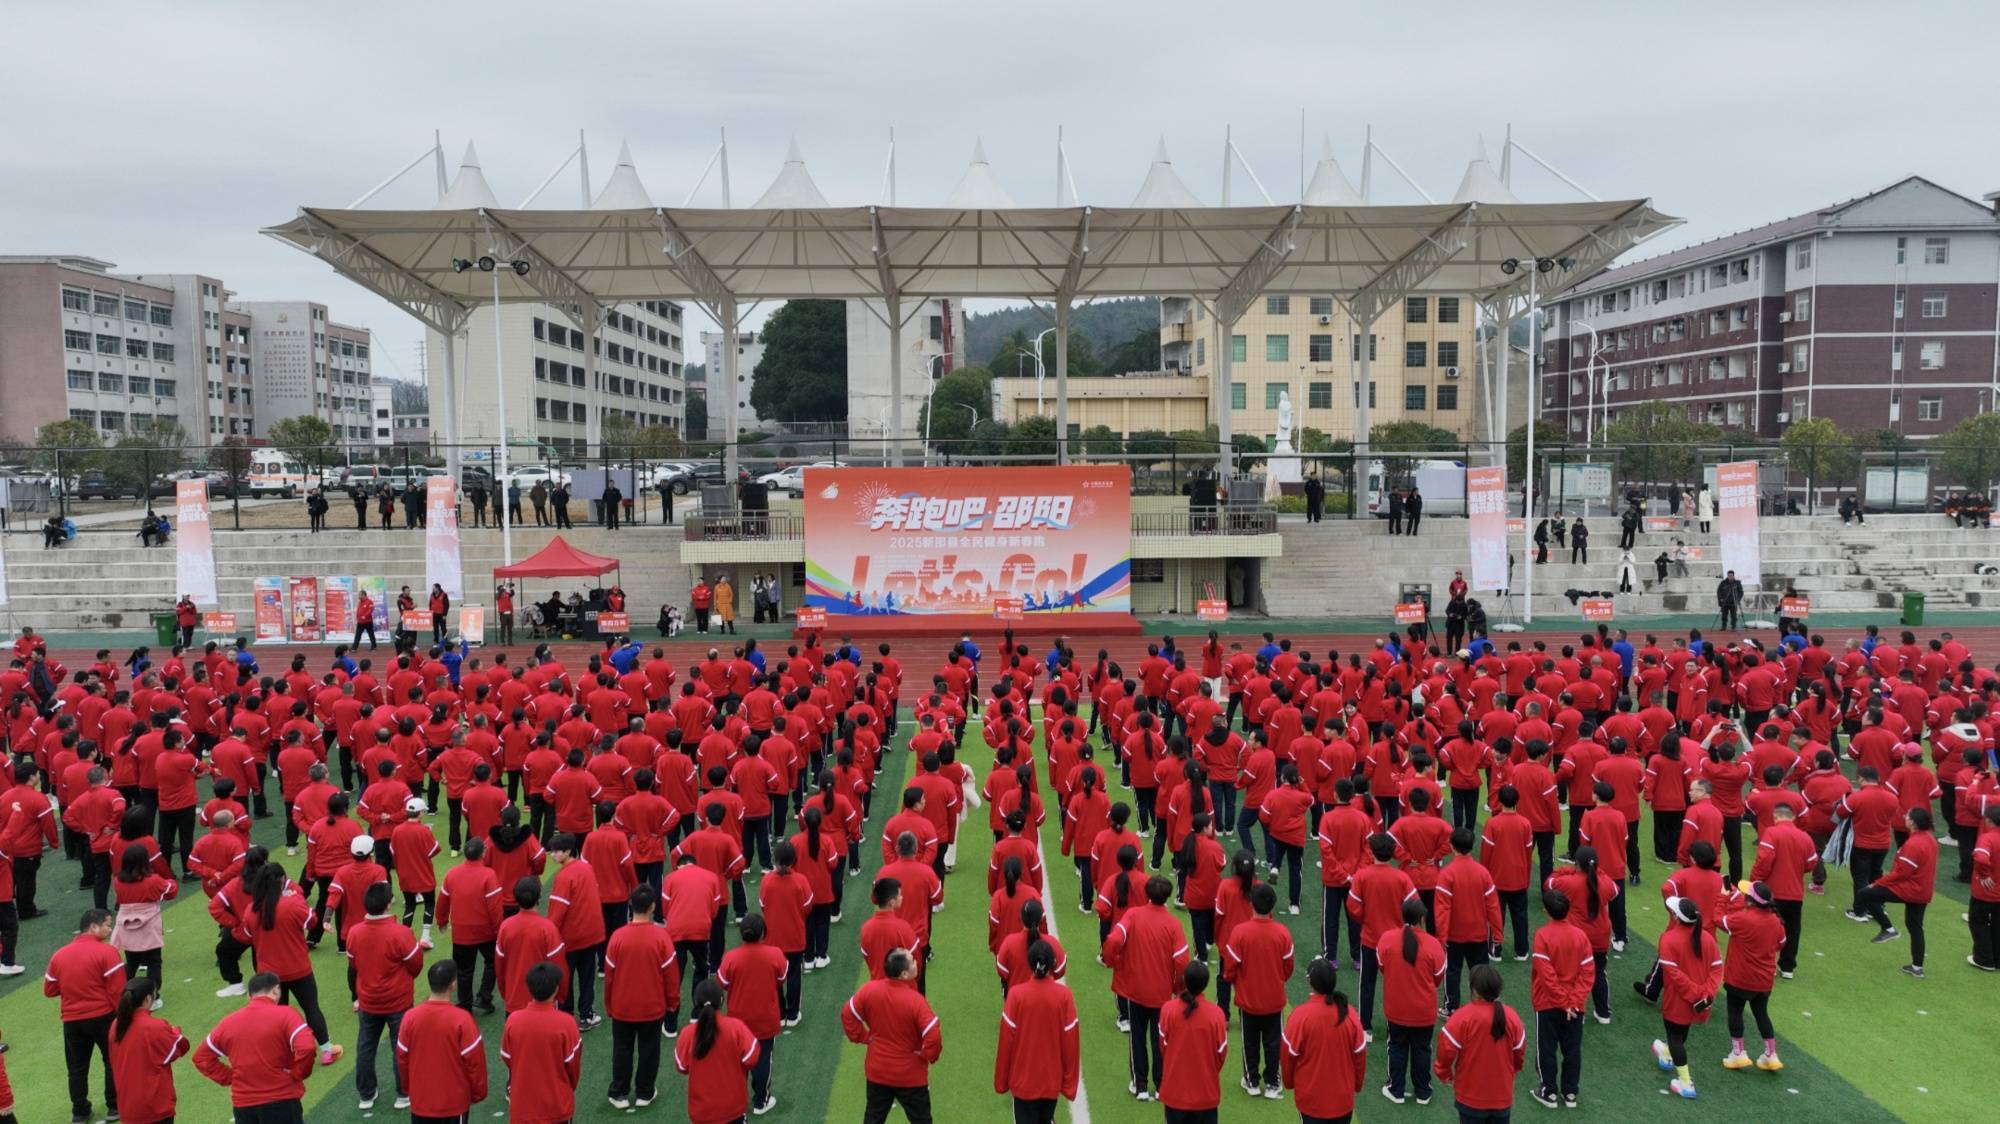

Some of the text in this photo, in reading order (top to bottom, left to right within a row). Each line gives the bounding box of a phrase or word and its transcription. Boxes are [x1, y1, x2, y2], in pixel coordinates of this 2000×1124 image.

[870, 496, 1074, 531] 奔跑吧·邵阳
[889, 536, 1046, 549] 2025新邵县全民健身新春跑
[851, 553, 1089, 596] Let's Go!
